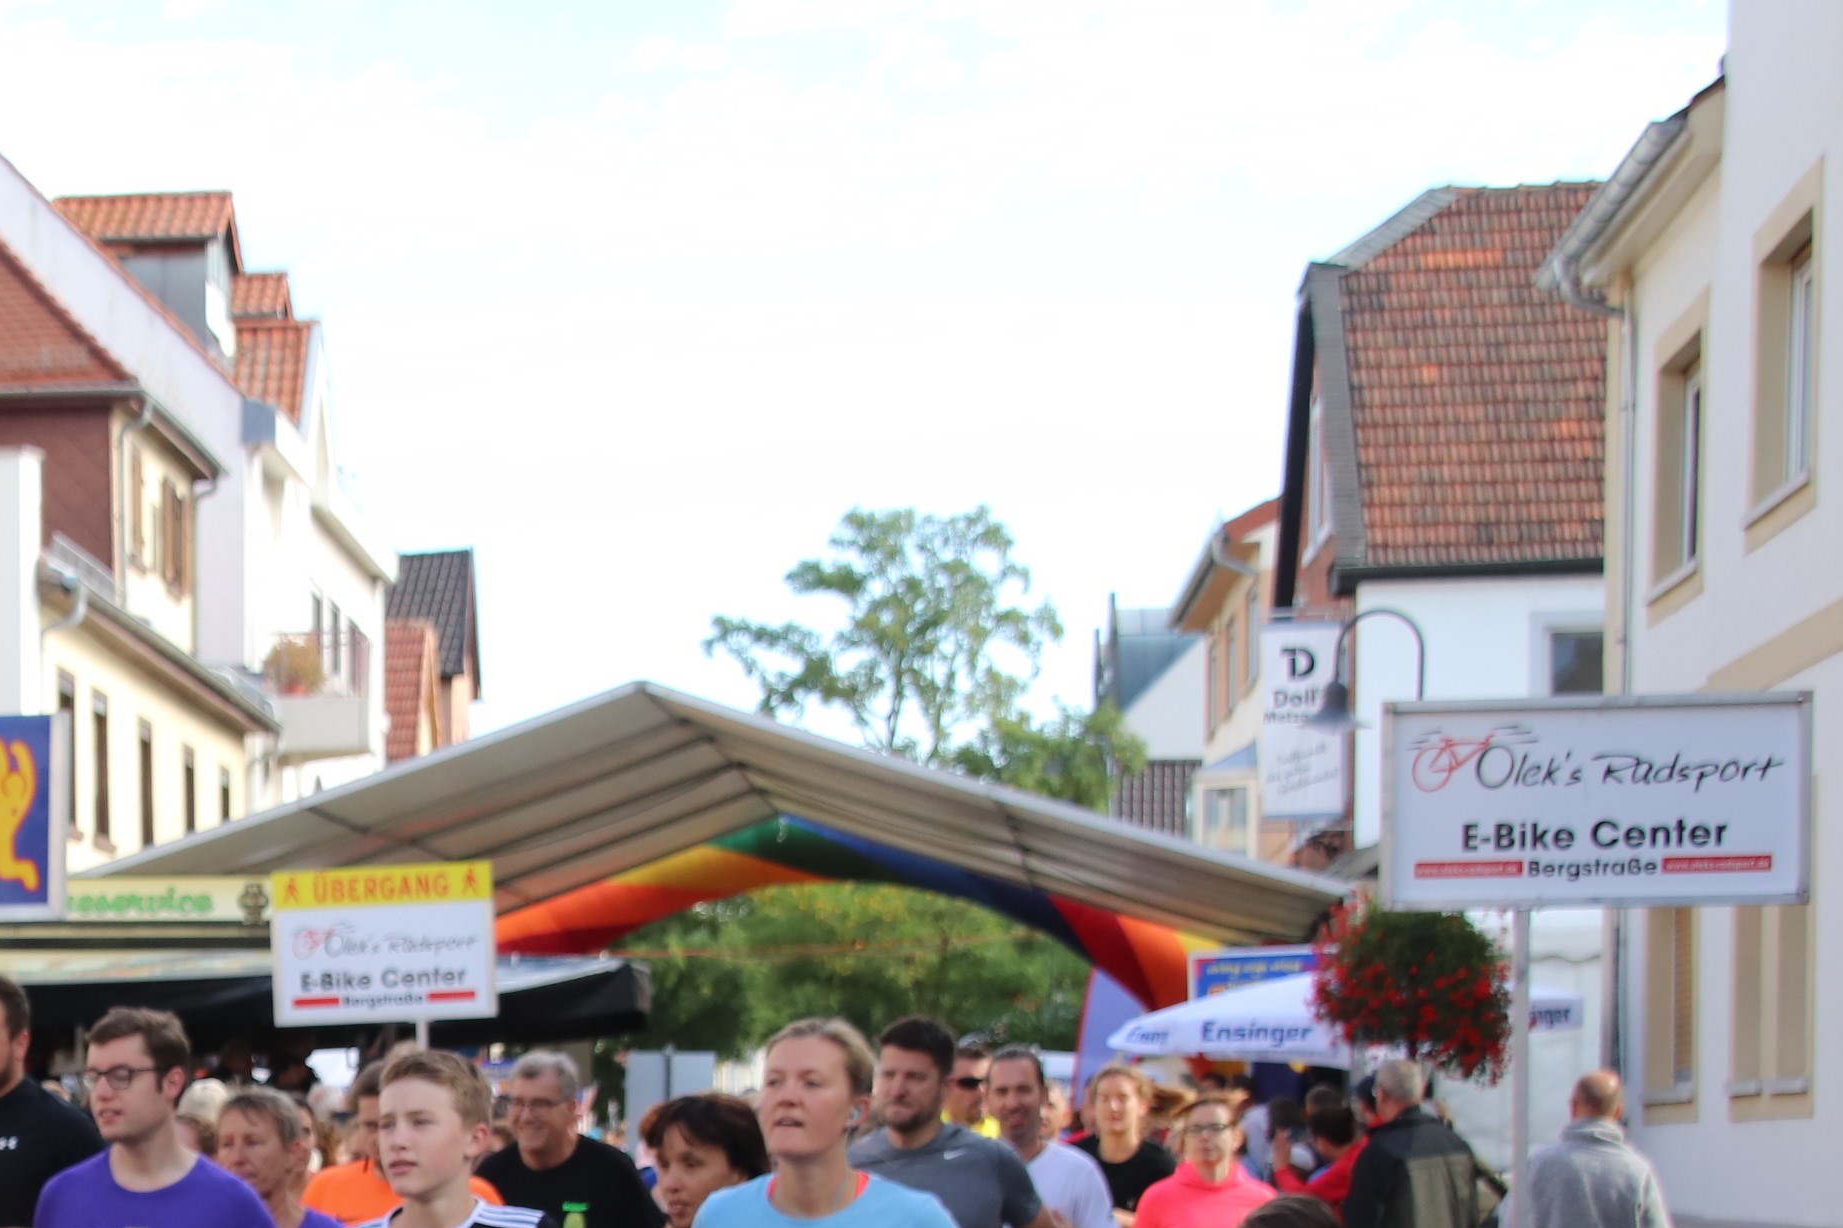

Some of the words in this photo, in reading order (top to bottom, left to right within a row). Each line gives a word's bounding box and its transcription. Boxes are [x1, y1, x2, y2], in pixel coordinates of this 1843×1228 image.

[1475, 744, 1583, 790] Olek's
[1591, 751, 1786, 794] Radsport
[1461, 820, 1575, 853] E-Bike
[1589, 816, 1729, 850] Center
[313, 866, 449, 905] ÜBERGANG
[1527, 857, 1658, 883] Bergstraße
[300, 970, 371, 992] E-Bike
[380, 967, 467, 989] Center
[1202, 1020, 1312, 1047] Ensinger
